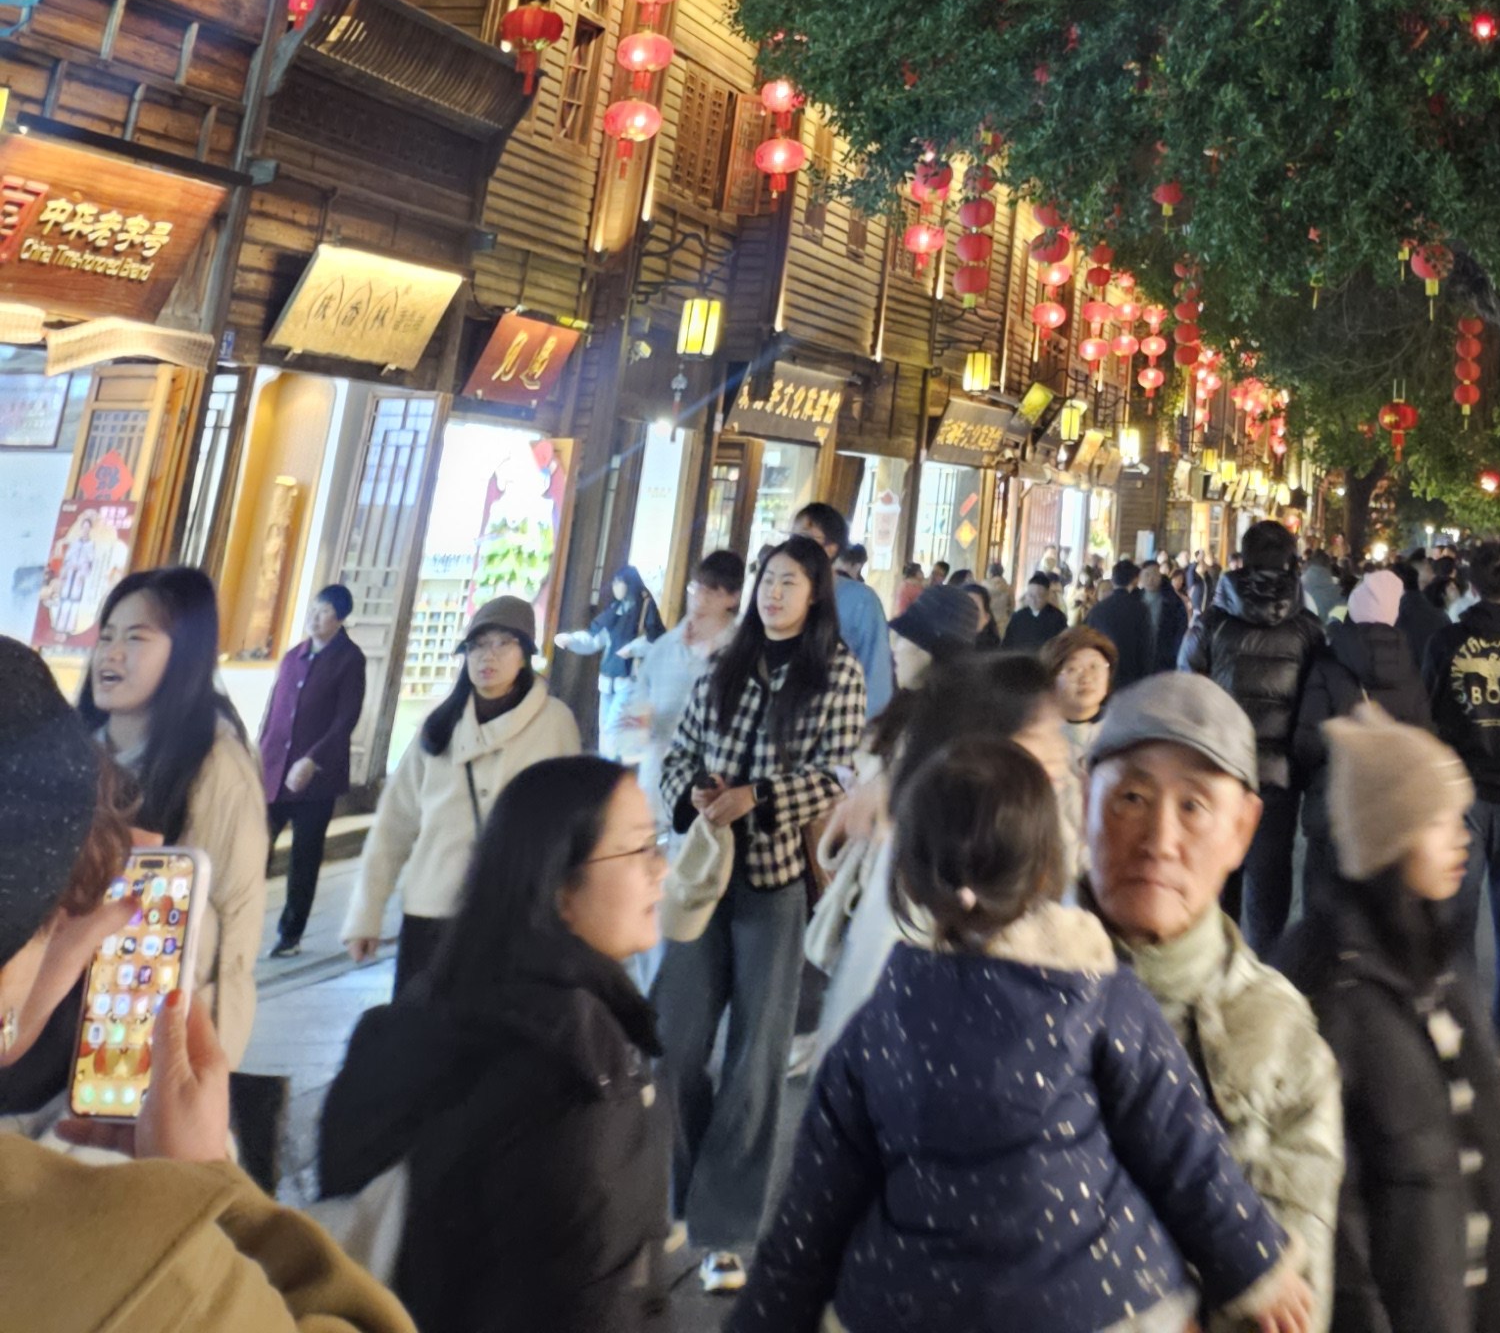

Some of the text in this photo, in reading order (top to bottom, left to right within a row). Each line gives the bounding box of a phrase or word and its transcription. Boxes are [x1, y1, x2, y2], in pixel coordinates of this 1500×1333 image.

[39, 198, 173, 258] 中华老字号
[20, 238, 155, 282] China Time-honored Brand
